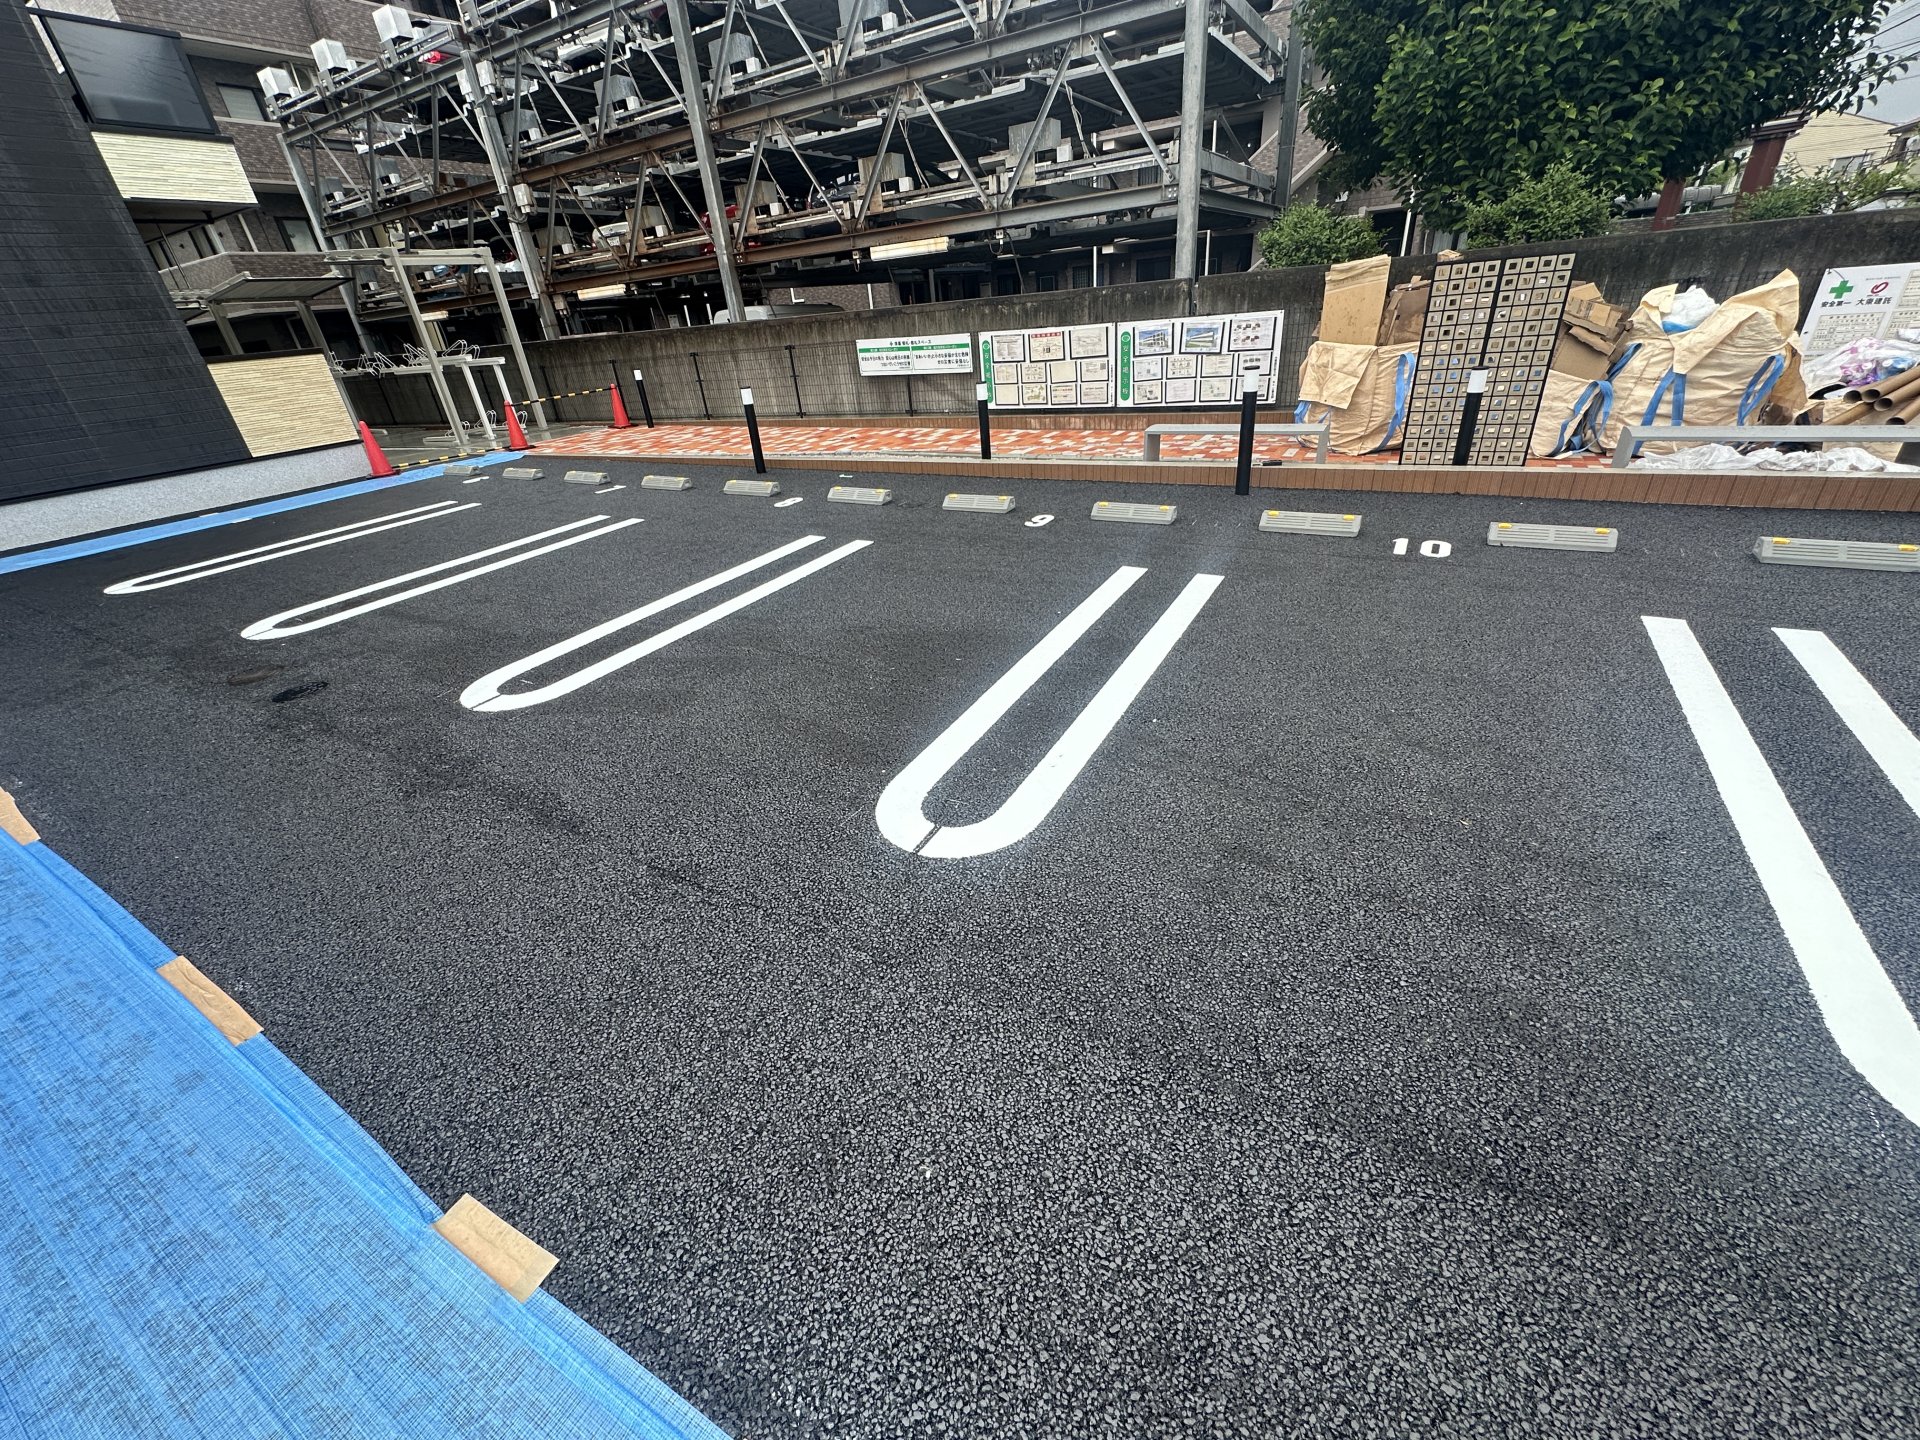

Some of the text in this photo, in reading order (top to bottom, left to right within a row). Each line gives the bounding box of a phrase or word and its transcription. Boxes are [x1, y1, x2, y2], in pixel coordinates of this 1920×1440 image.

[774, 497, 804, 508] 8
[1024, 514, 1055, 527] 9
[1392, 537, 1452, 558] 10
